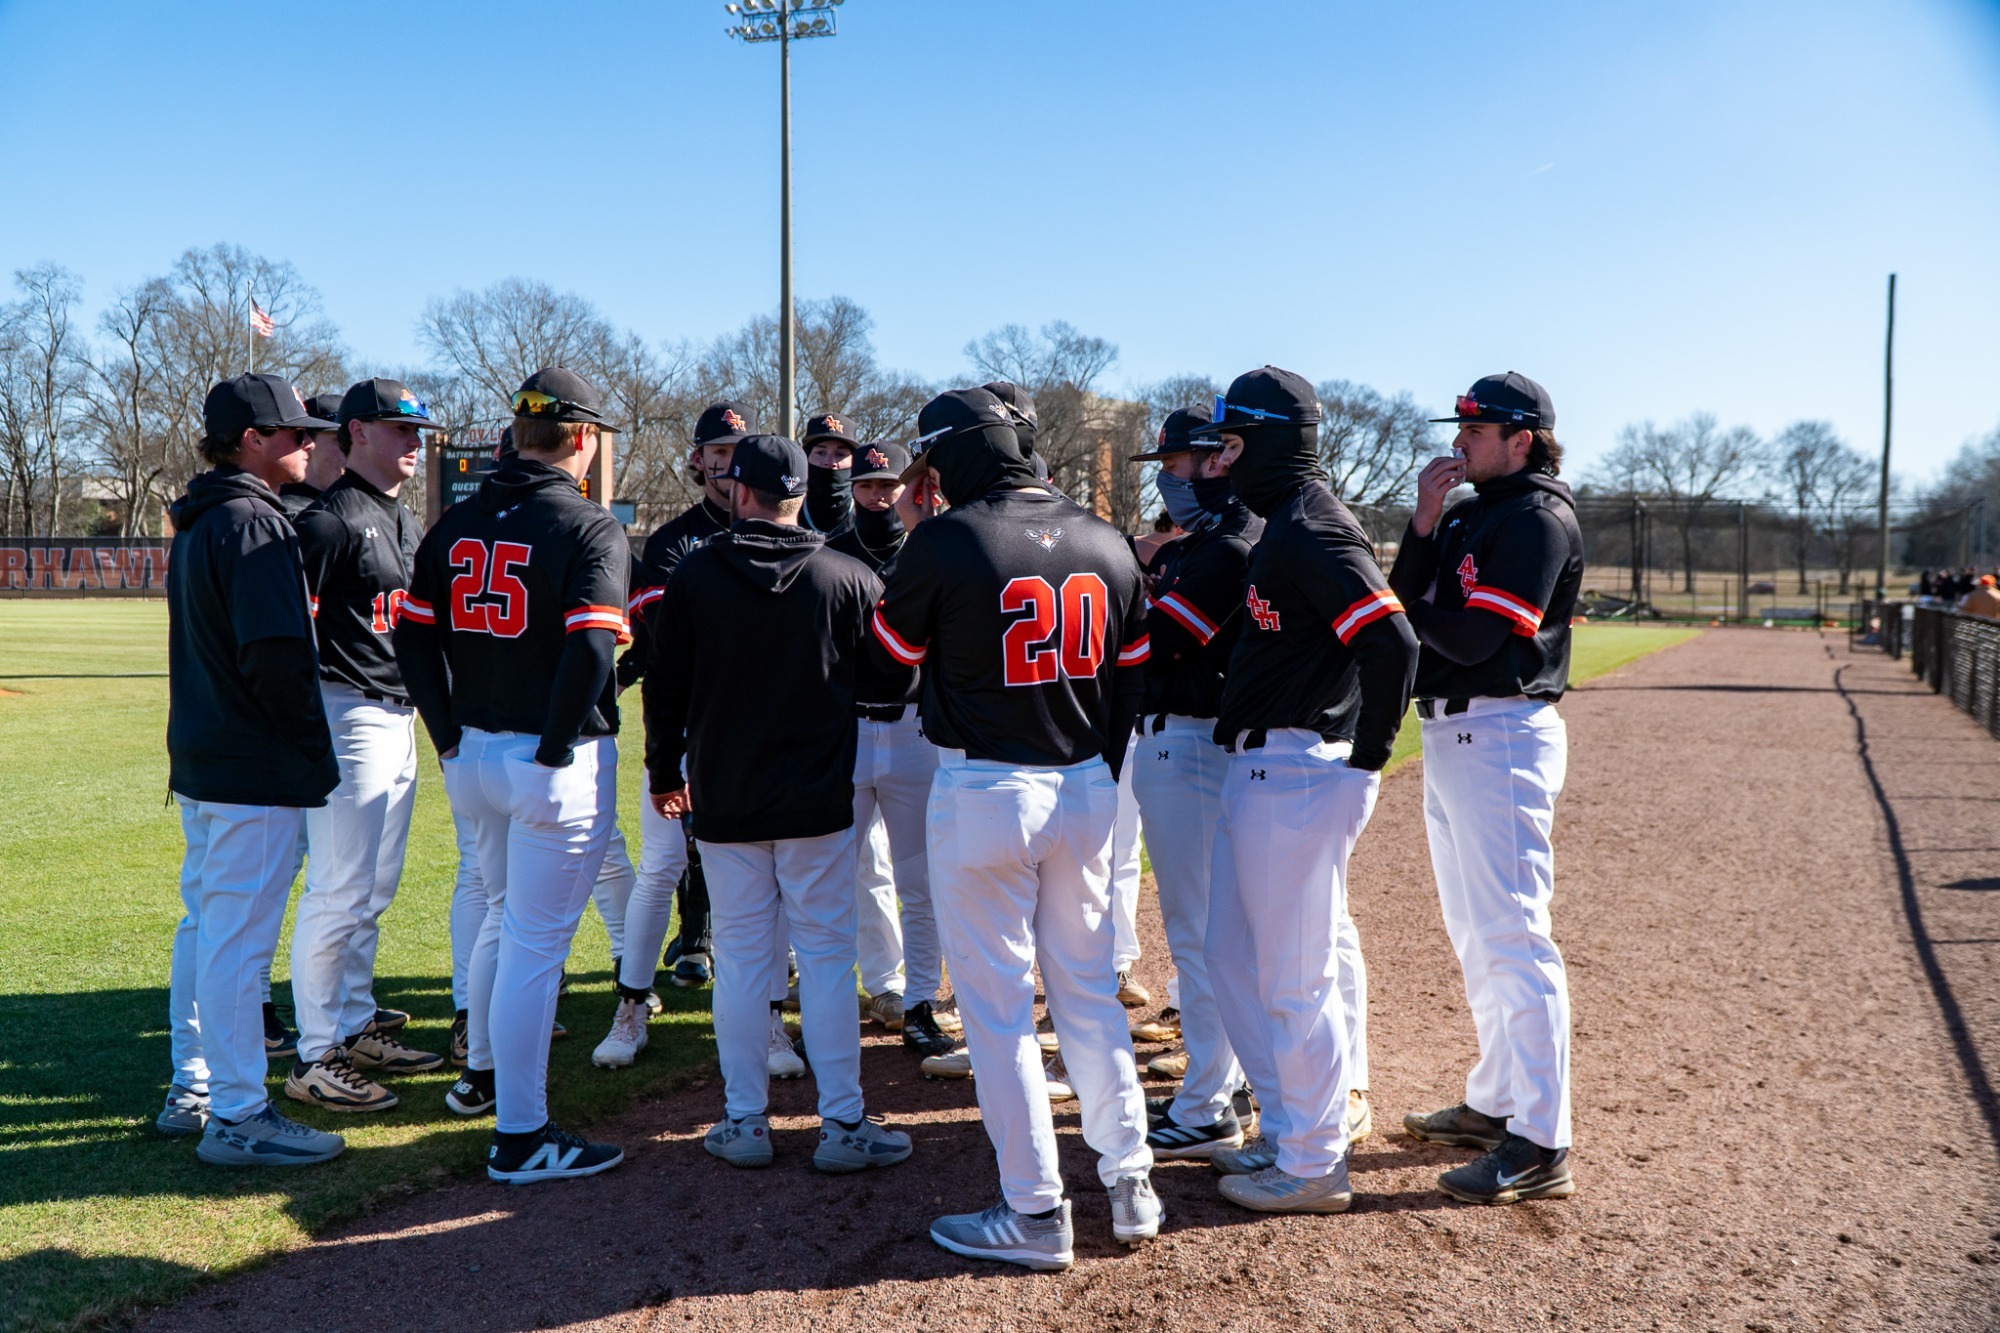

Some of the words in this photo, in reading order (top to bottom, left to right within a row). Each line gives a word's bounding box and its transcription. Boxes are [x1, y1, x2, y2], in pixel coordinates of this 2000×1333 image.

[446, 451, 474, 459] BATTER
[459, 458, 468, 473] 0
[451, 482, 480, 491] GUEST
[455, 494, 472, 504] HO
[449, 537, 533, 639] 25
[1000, 572, 1109, 687] 20
